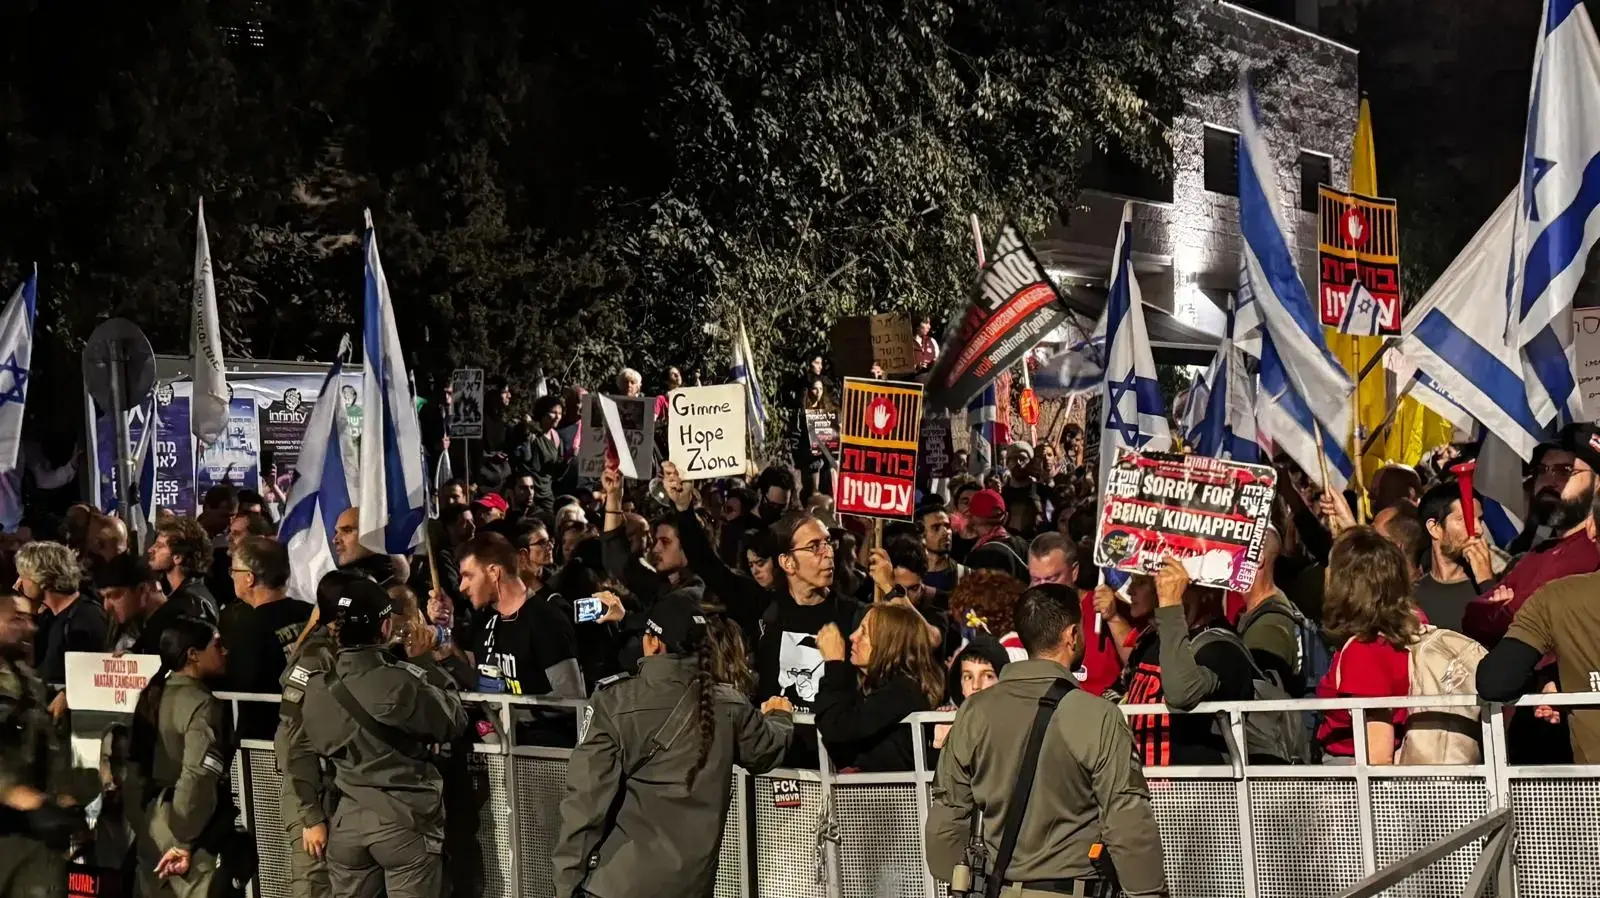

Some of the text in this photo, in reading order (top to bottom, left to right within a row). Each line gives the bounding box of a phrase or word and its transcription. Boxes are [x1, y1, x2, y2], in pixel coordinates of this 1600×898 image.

[269, 409, 307, 424] infinity
[672, 393, 731, 416] Gimme
[680, 424, 724, 452] Hope
[687, 447, 739, 472] Ziona
[842, 449, 913, 477] בחירות
[842, 476, 912, 512] עכשיו!
[1142, 474, 1198, 501] SORRY
[1201, 482, 1234, 507] FOR
[1111, 501, 1254, 541] BEING KIDNAPPED
[94, 674, 113, 688] MATAN
[114, 690, 127, 705] (24)
[772, 779, 799, 793] FCK
